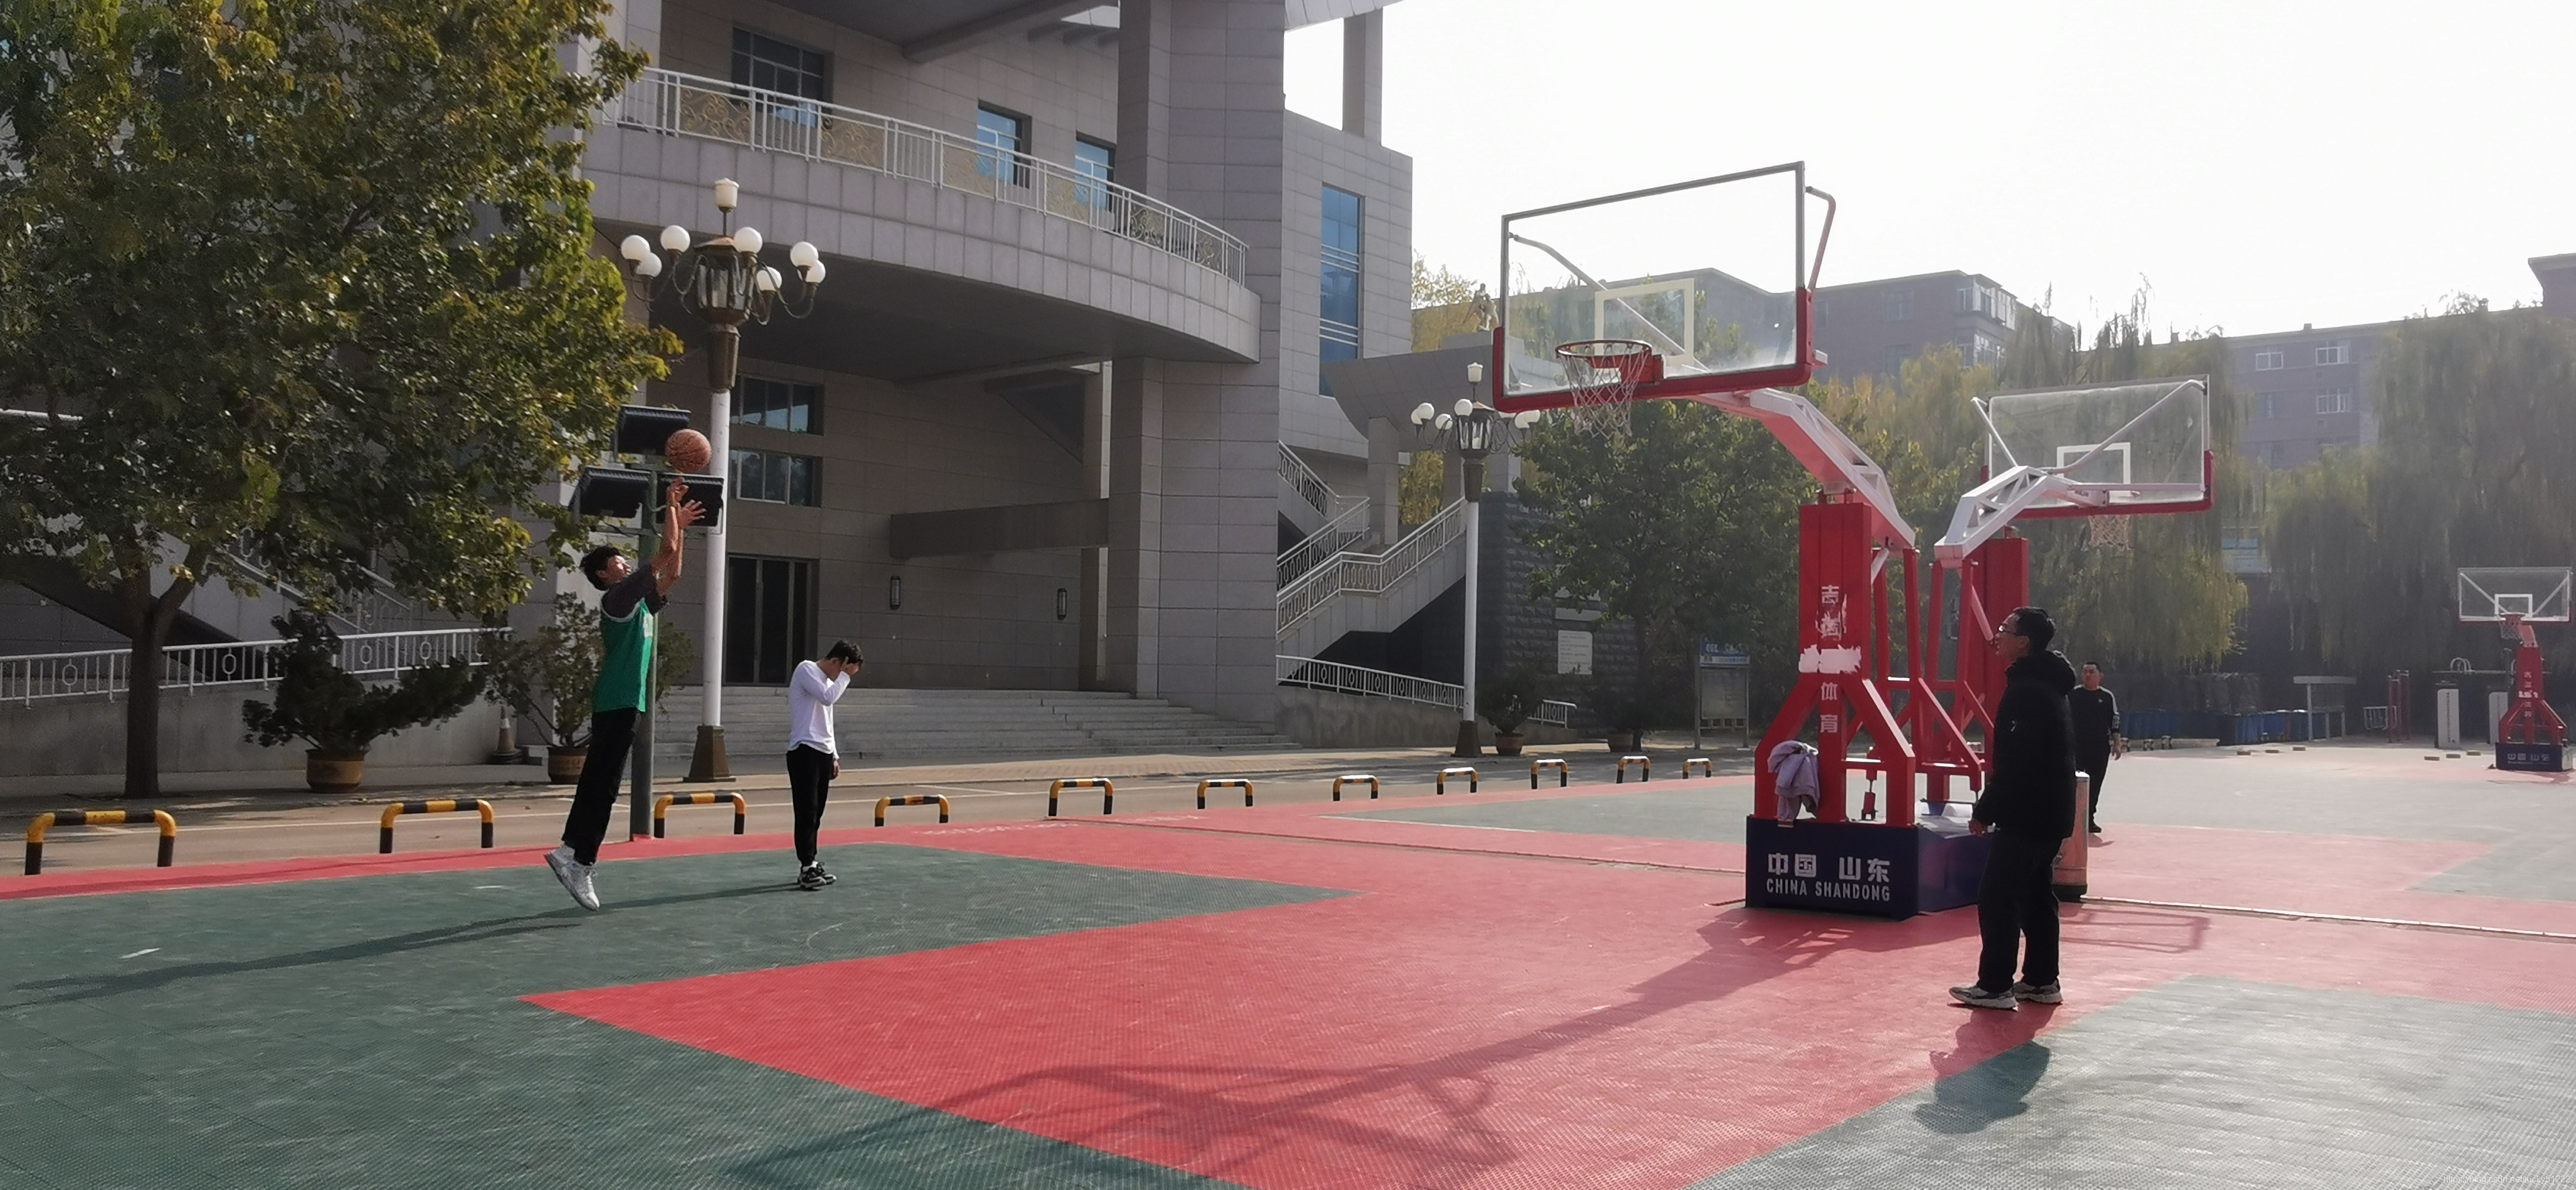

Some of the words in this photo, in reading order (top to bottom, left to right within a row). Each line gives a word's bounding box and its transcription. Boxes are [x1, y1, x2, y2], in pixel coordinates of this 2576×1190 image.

[1768, 853, 1817, 877] 中国
[1839, 857, 1890, 882] 山东
[1767, 878, 1807, 895] CHINA
[1815, 881, 1890, 901] SHANDONG
